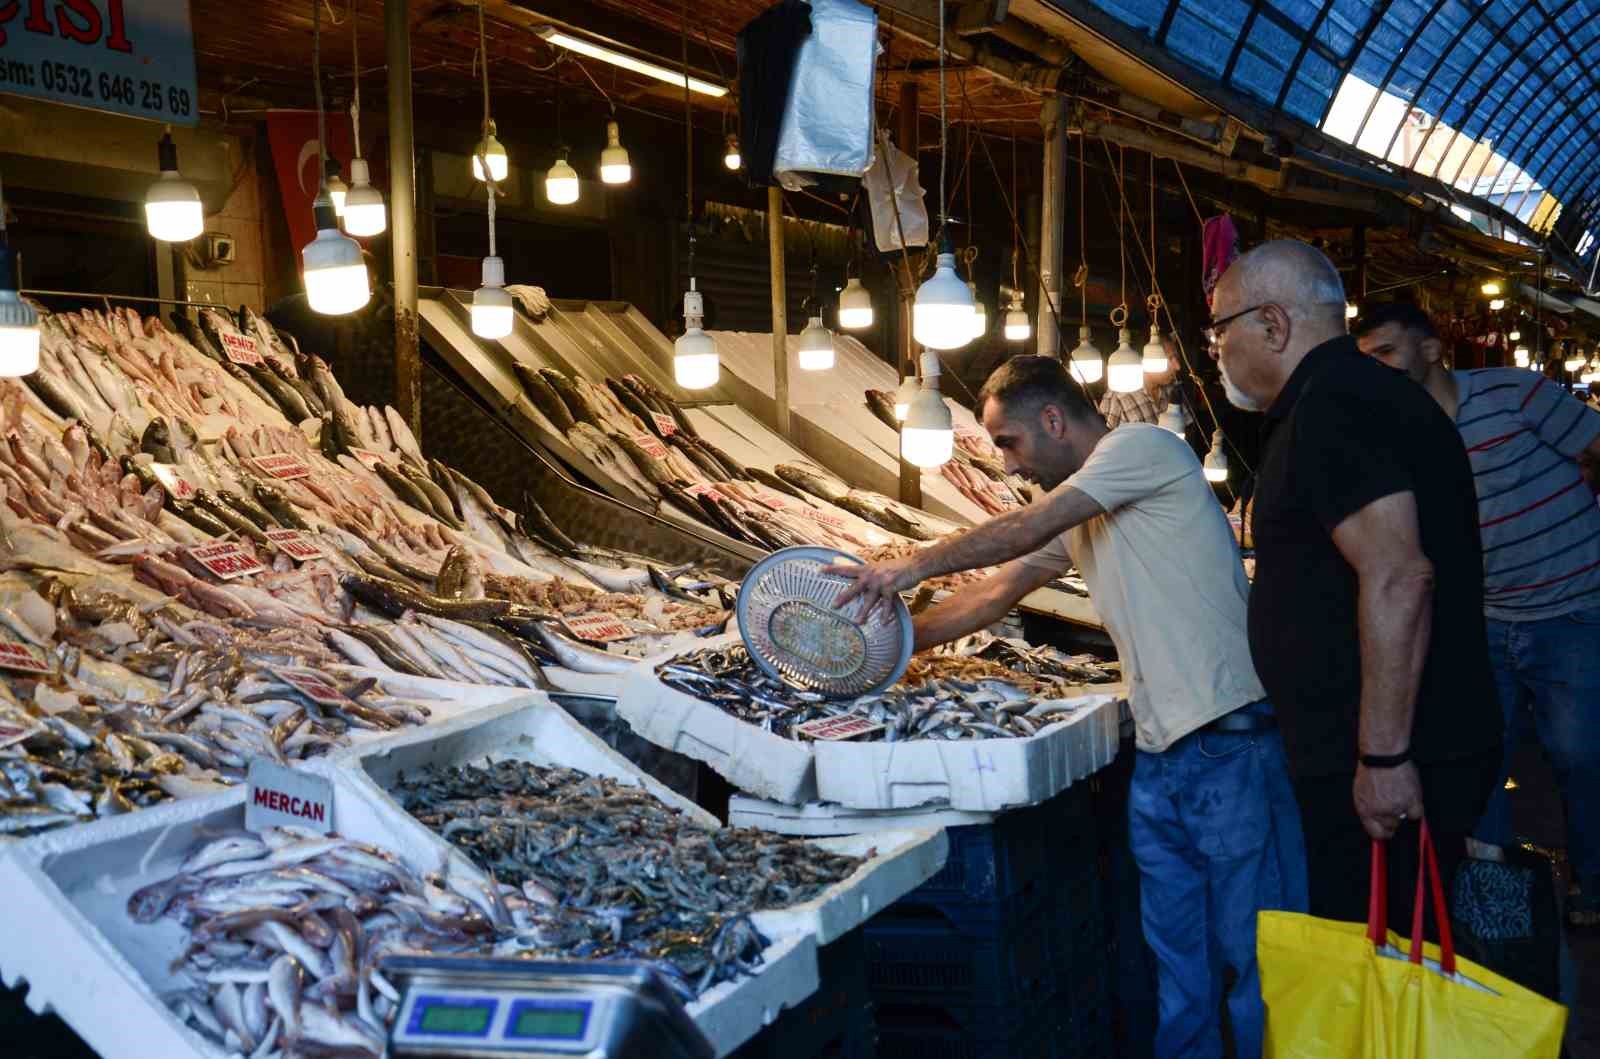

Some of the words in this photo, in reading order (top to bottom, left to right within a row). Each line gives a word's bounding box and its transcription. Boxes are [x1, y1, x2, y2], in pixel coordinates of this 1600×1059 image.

[41, 59, 94, 98] 0532
[98, 72, 135, 106] 646
[141, 81, 163, 111] 25
[168, 86, 191, 116] 69
[254, 786, 324, 824] MERCAN
